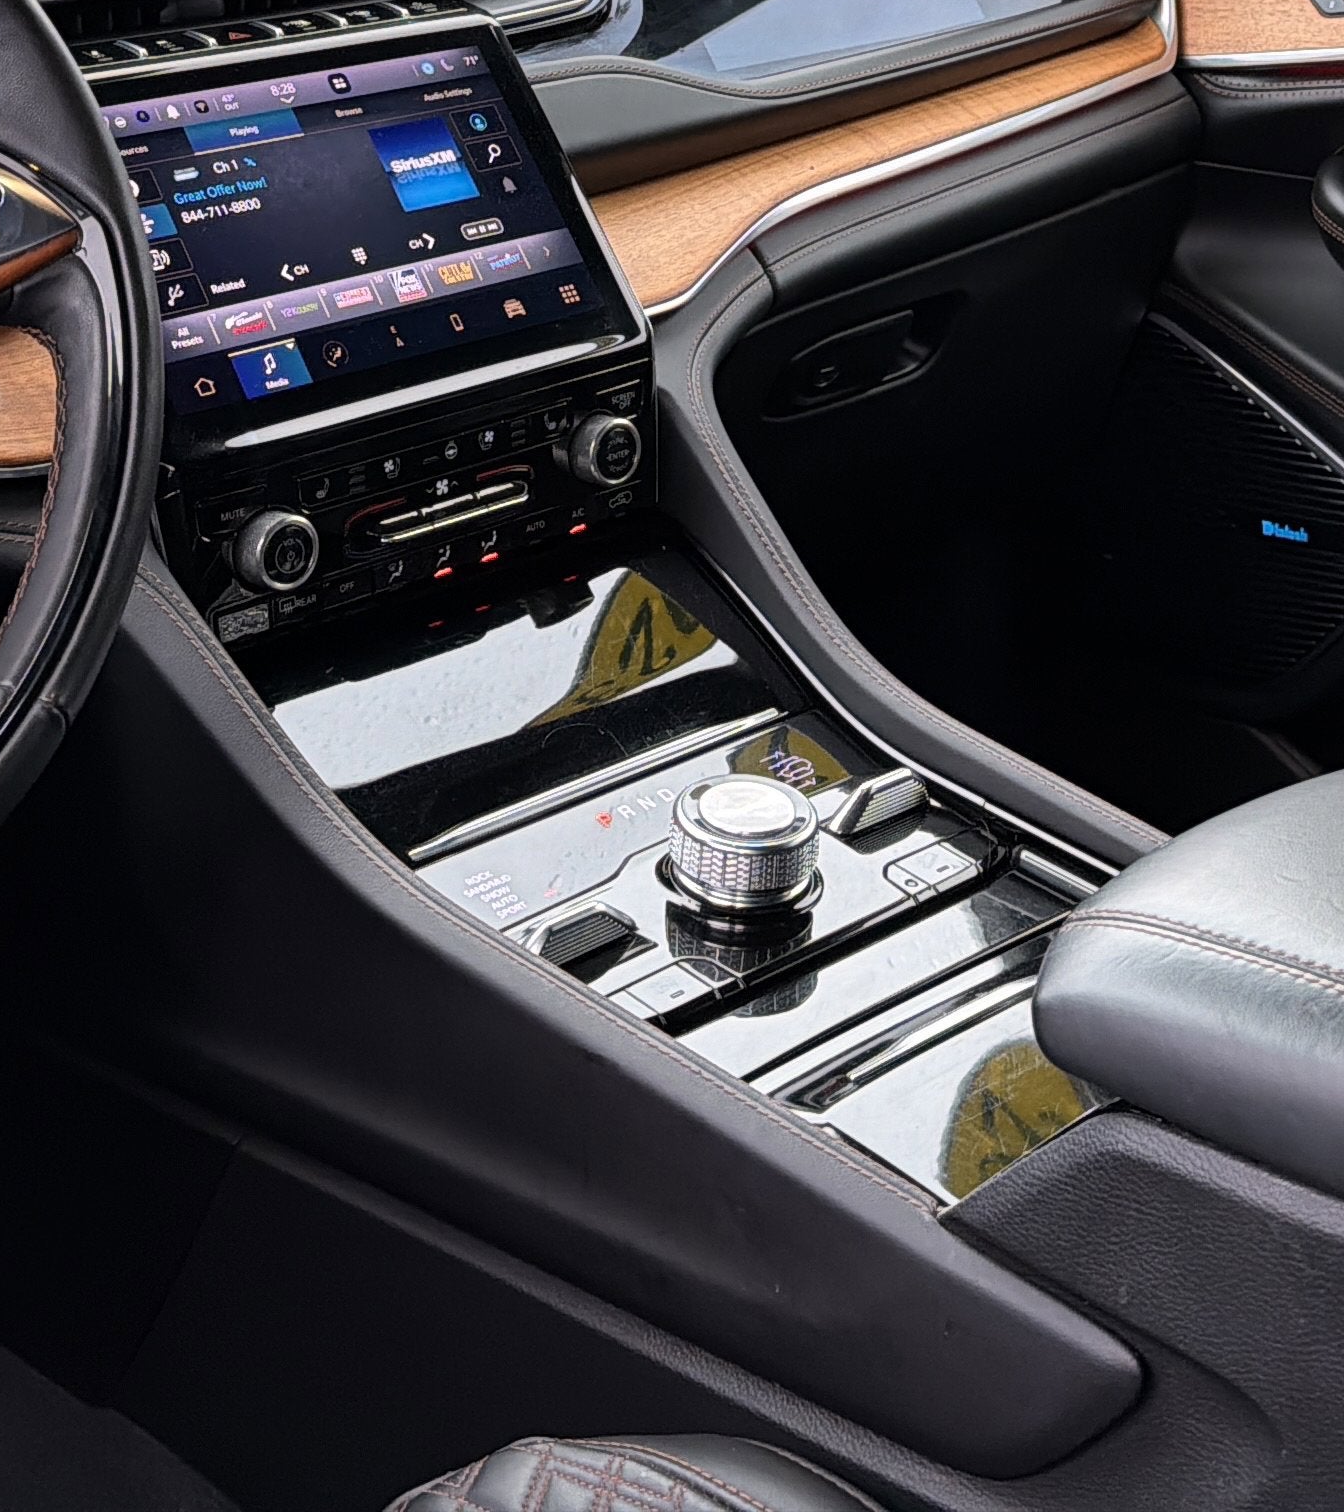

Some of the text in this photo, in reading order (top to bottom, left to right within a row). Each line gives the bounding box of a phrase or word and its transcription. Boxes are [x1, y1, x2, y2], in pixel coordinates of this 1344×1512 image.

[270, 82, 297, 96] 8:28
[424, 87, 472, 102] Audio Settings
[224, 102, 239, 111] OUT
[335, 107, 363, 118] Browse
[229, 125, 260, 137] Playing
[119, 145, 149, 157] ources
[213, 159, 239, 174] Ch 1
[390, 149, 456, 173] SiriusXM
[173, 176, 268, 205] Great Offer Now!
[181, 197, 261, 224] 844-711-8800
[408, 238, 424, 250] CH
[293, 263, 310, 276] CH
[210, 278, 246, 295] Related
[177, 326, 189, 337] All
[171, 335, 204, 350] Presets
[265, 377, 289, 390] Media
[611, 391, 636, 404] SCREEN
[619, 399, 632, 410] OFF
[221, 508, 245, 522] MUTE
[526, 520, 545, 532] AUTO
[296, 594, 316, 607] REAR
[617, 804, 636, 819] R
[636, 796, 657, 811] N
[657, 788, 676, 802] D
[464, 870, 493, 886] ROCK
[480, 886, 510, 903] SNOW
[491, 894, 518, 910] AUTO
[497, 901, 528, 920] SPORT
